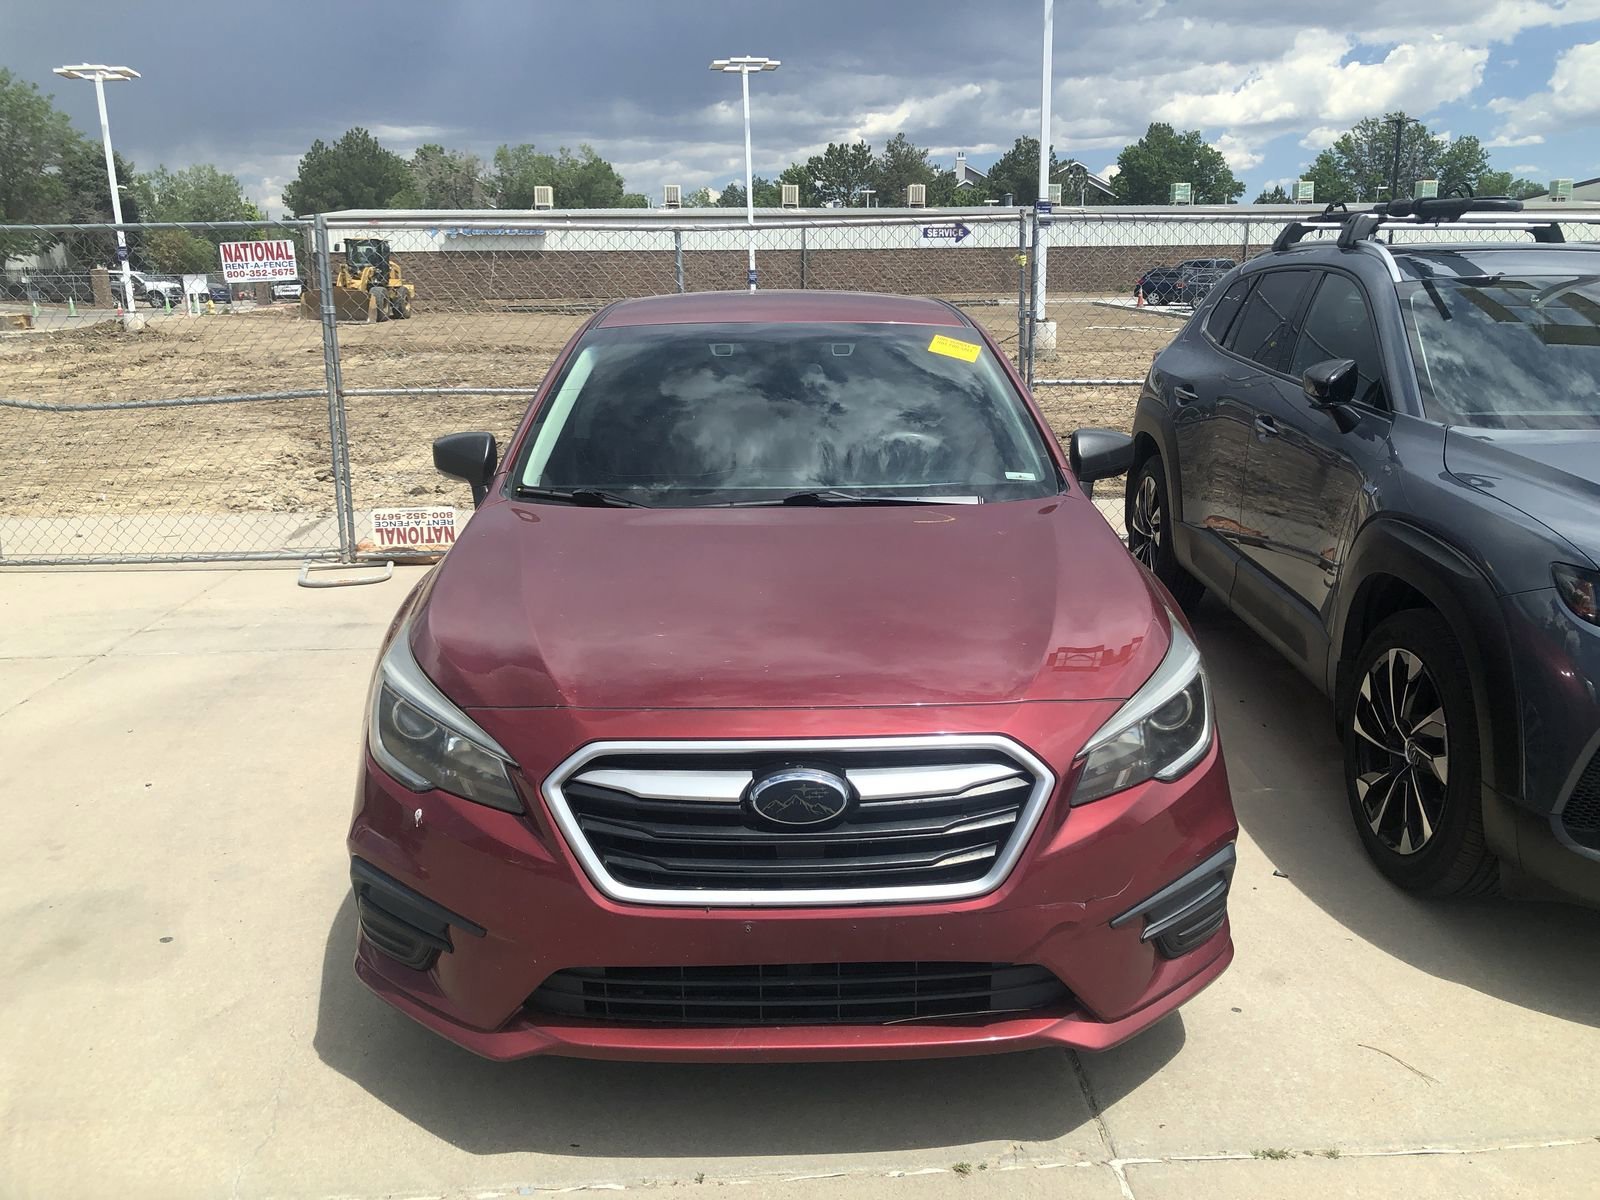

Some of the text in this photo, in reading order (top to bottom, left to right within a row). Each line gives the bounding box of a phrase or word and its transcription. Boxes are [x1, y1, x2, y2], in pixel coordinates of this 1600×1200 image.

[927, 228, 964, 237] SERVICE
[222, 242, 294, 262] NATIONAL
[225, 261, 295, 270] RENT-A-FENCE
[226, 268, 295, 278] 800-352-5675
[374, 511, 454, 521] 800-352-5675
[375, 519, 454, 527] RENT-A-FENCE
[375, 526, 456, 545] NATIONAL
